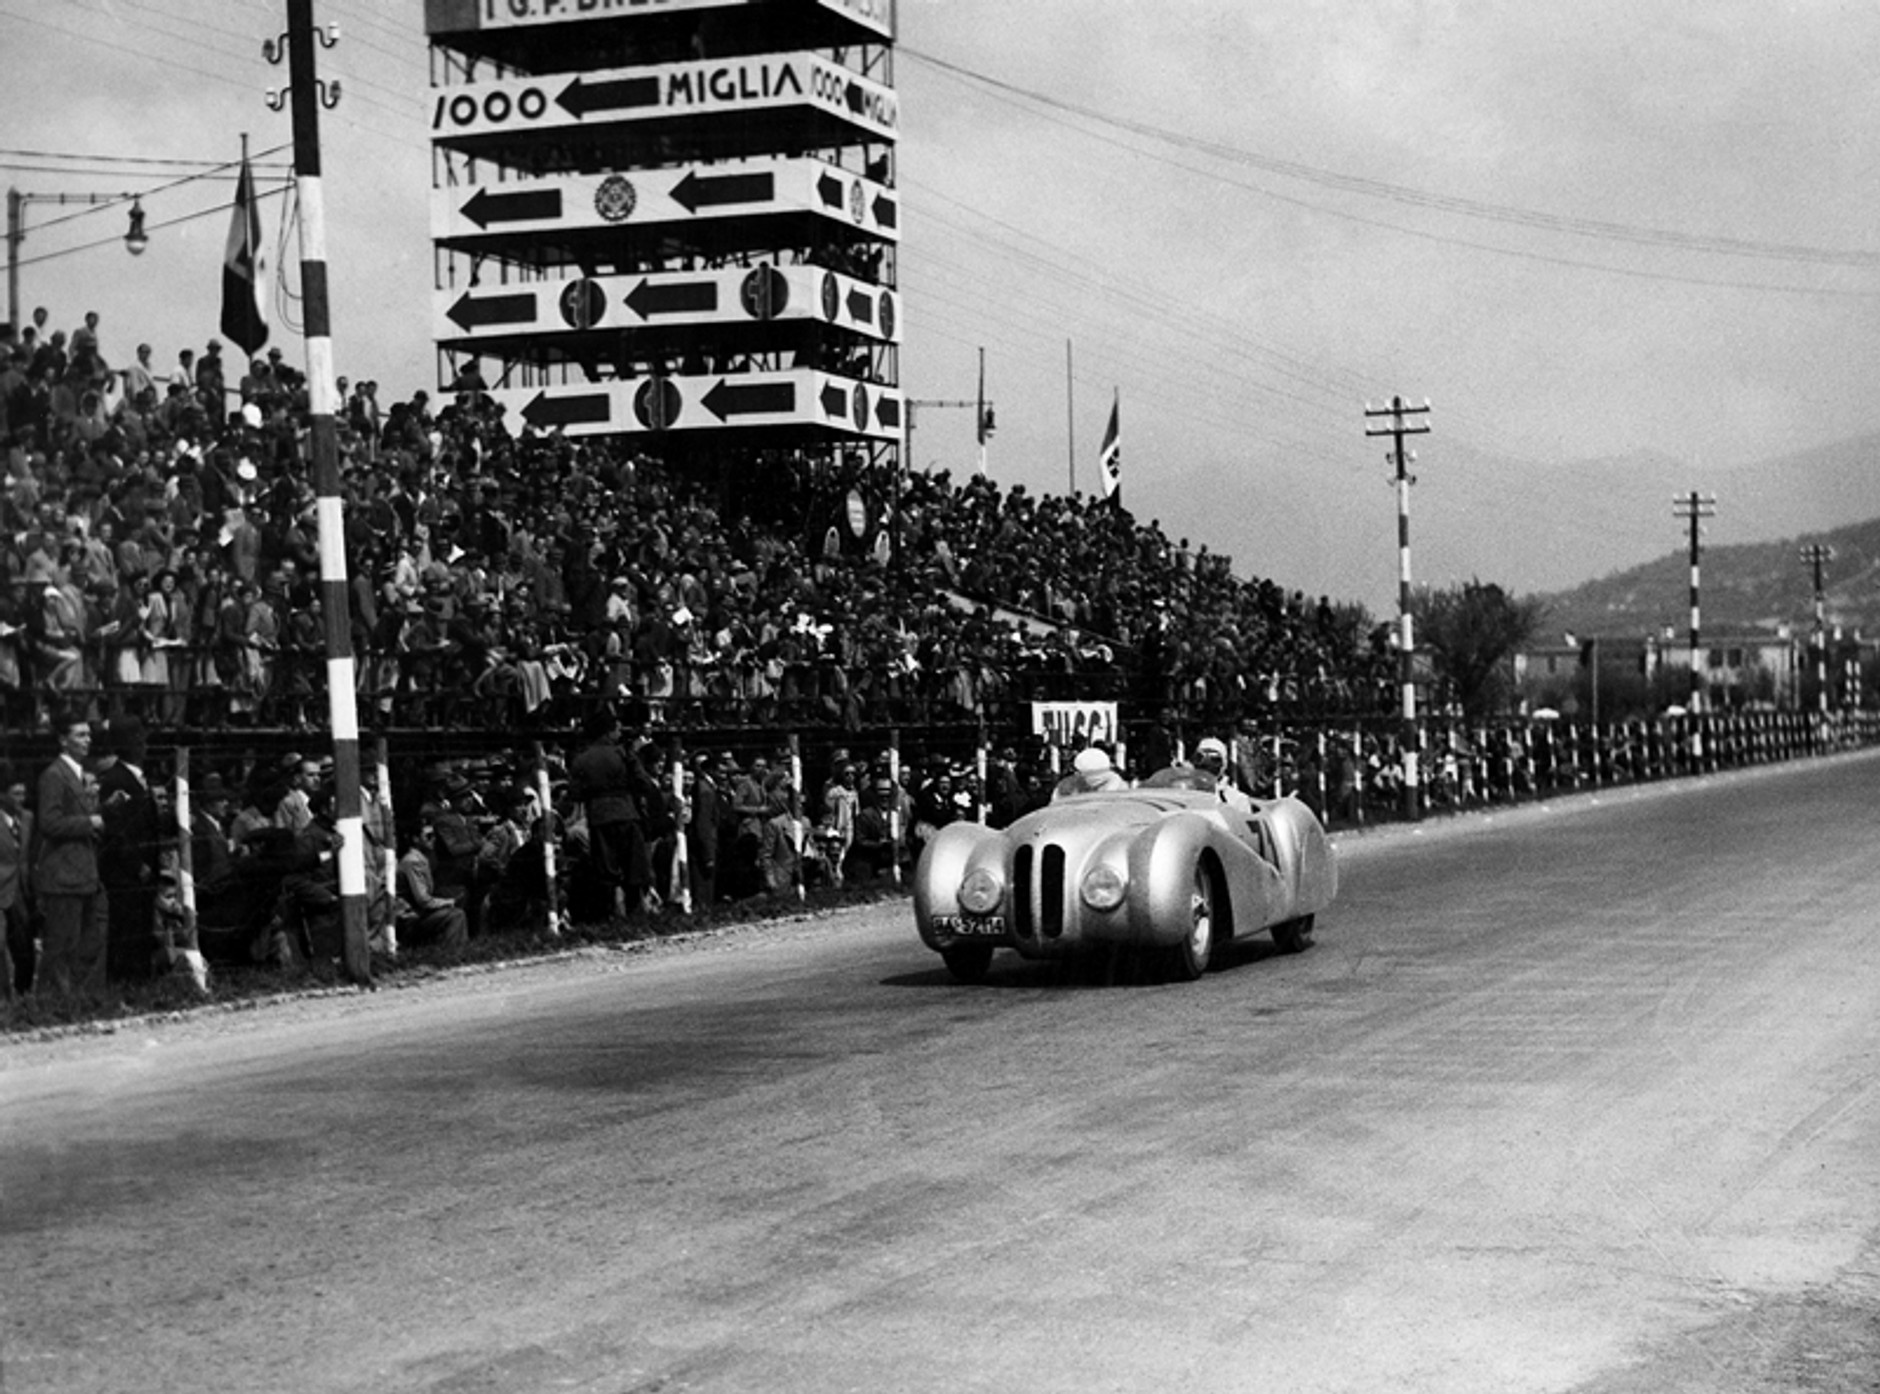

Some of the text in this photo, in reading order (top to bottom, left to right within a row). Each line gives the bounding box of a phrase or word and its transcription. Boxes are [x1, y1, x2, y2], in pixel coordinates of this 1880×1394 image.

[432, 62, 803, 130] 1000 MIGLIA
[810, 63, 843, 106] 1000
